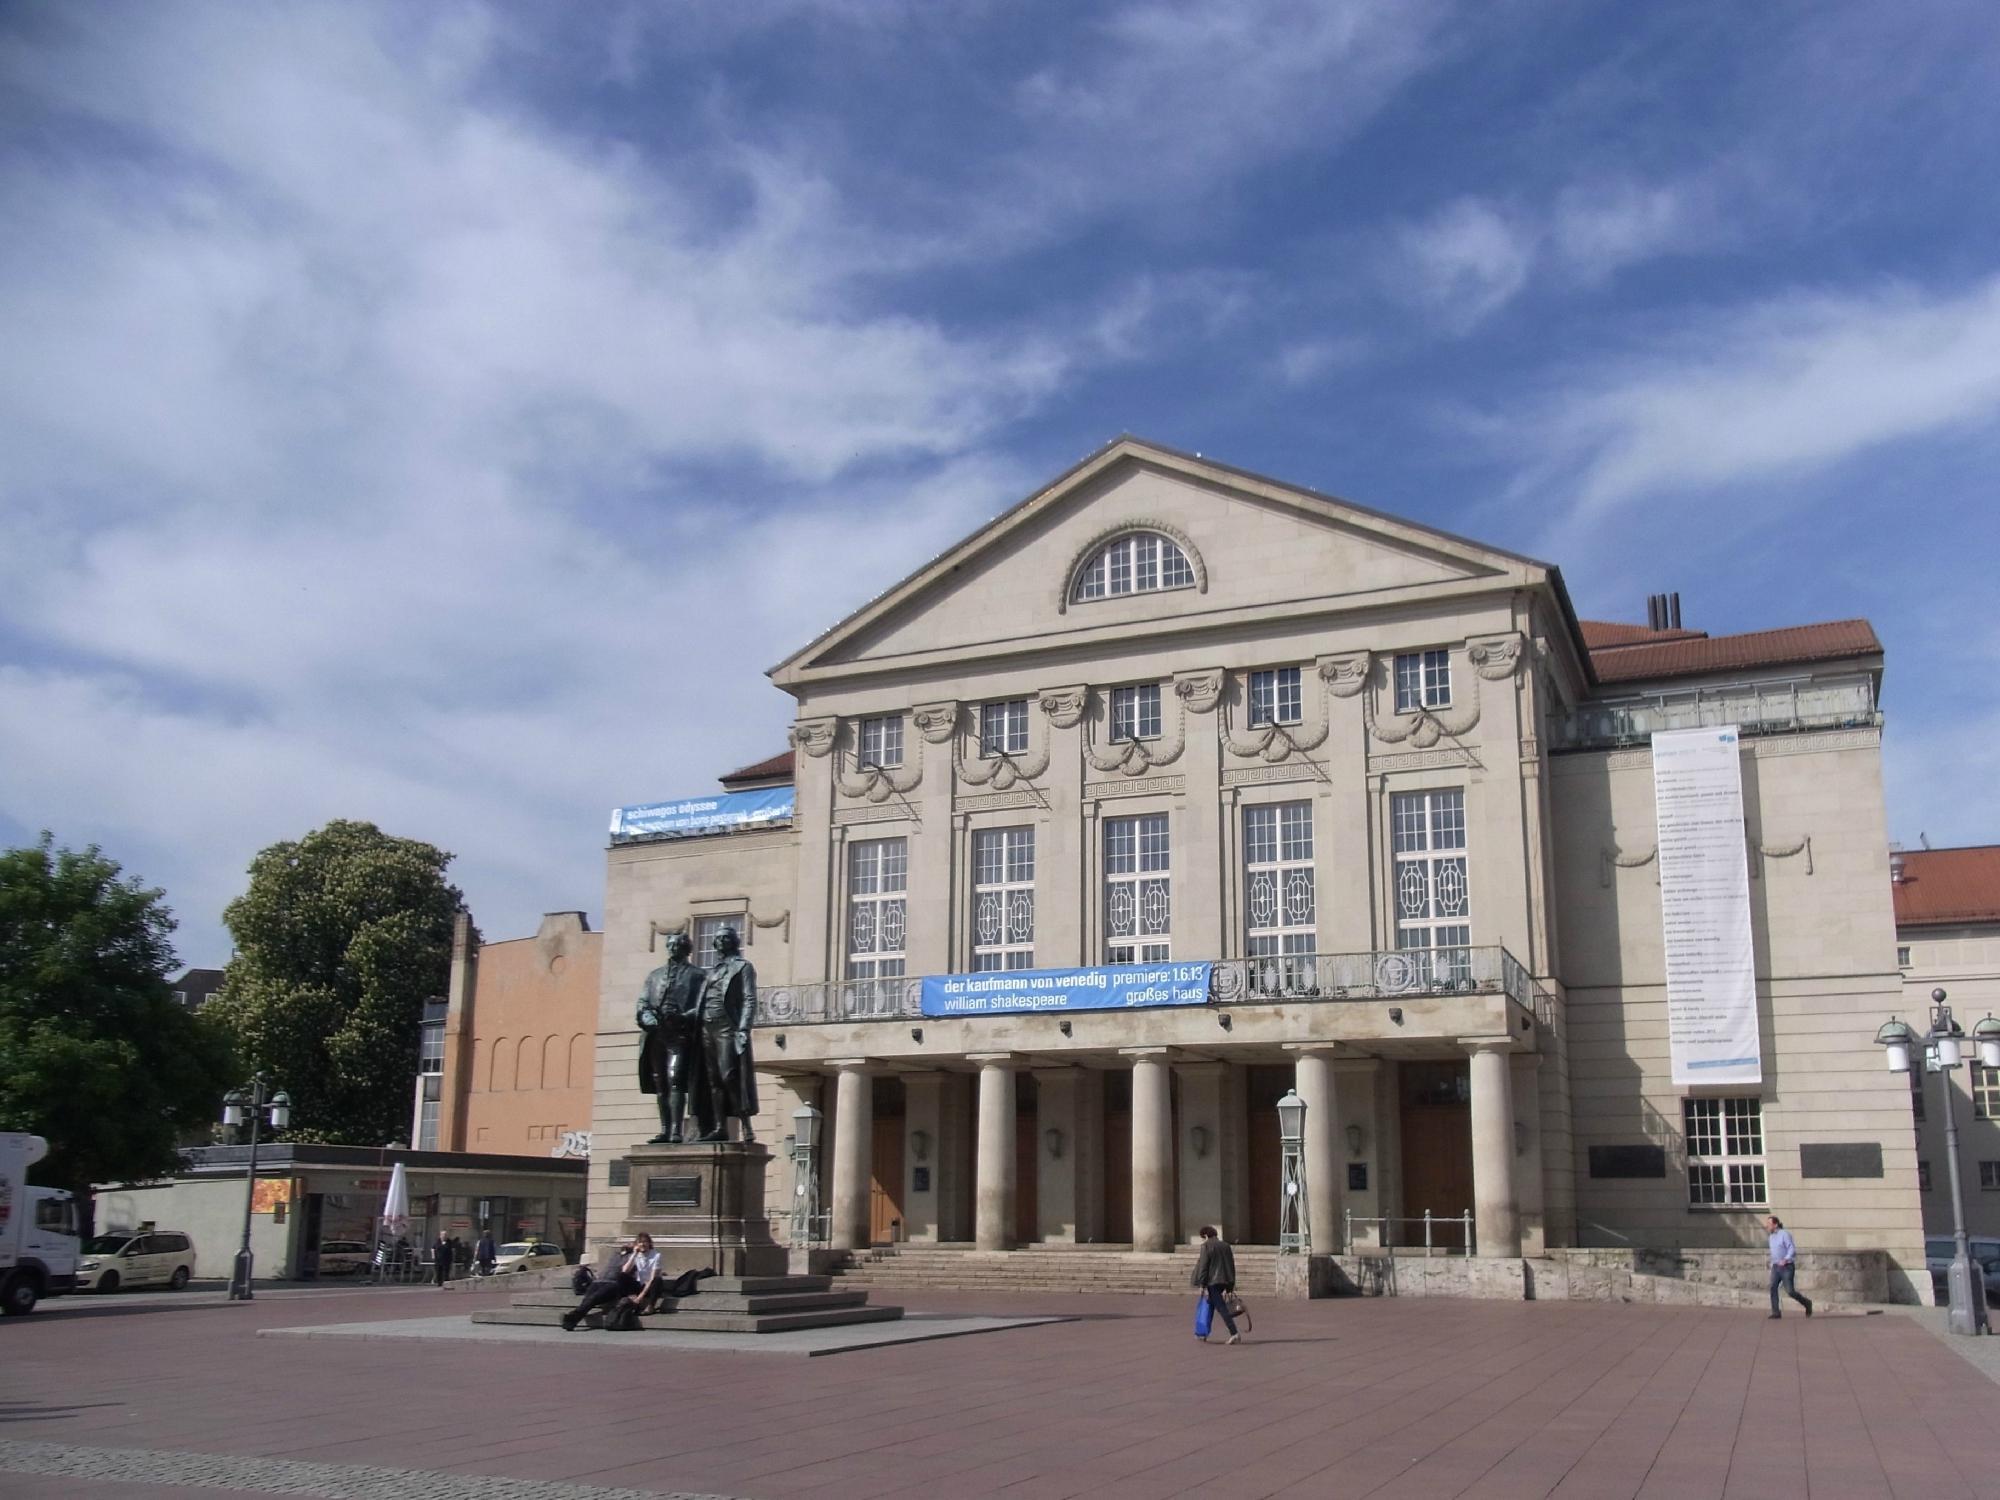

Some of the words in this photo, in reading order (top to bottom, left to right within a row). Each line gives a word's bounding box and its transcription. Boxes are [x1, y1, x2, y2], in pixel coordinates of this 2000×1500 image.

[944, 979, 966, 993] der
[966, 976, 1028, 992] kaufmann
[1030, 977, 1053, 989] von
[1055, 972, 1107, 988] venedig
[1113, 968, 1171, 988] premiere:
[1173, 966, 1203, 982] 1.6.13
[944, 996, 987, 1010] william
[991, 993, 1067, 1010] shakespeare
[1126, 987, 1169, 1005] großes
[1173, 986, 1203, 1000] haus
